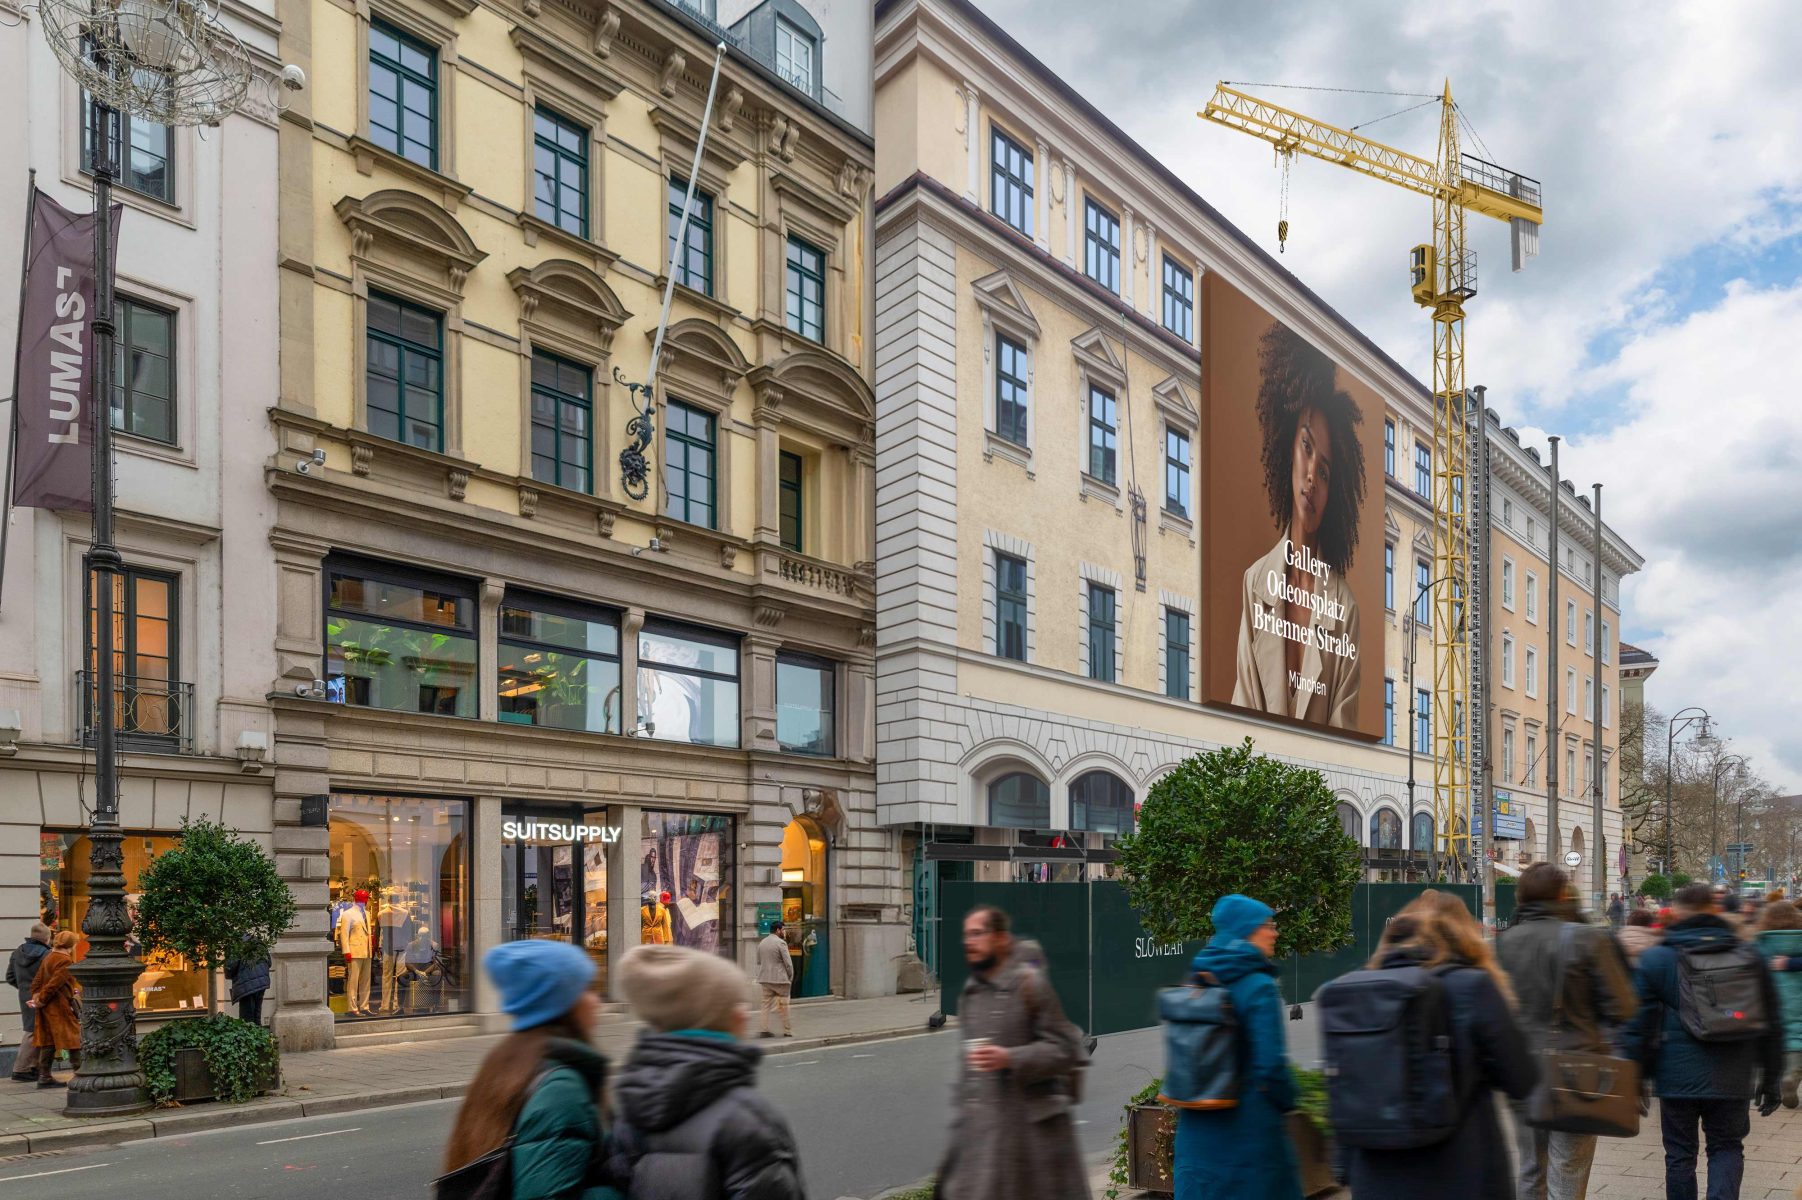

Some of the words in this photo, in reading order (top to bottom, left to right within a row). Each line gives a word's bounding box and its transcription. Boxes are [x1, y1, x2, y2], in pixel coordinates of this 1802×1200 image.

[48, 290, 86, 445] LUMAS
[1284, 539, 1331, 586] Gallery
[1266, 570, 1346, 622] Odeonsplatz
[1253, 602, 1314, 646] Brienner
[1316, 625, 1356, 660] Straße
[1288, 669, 1327, 696] München
[502, 822, 621, 842] SUITSUPPLY
